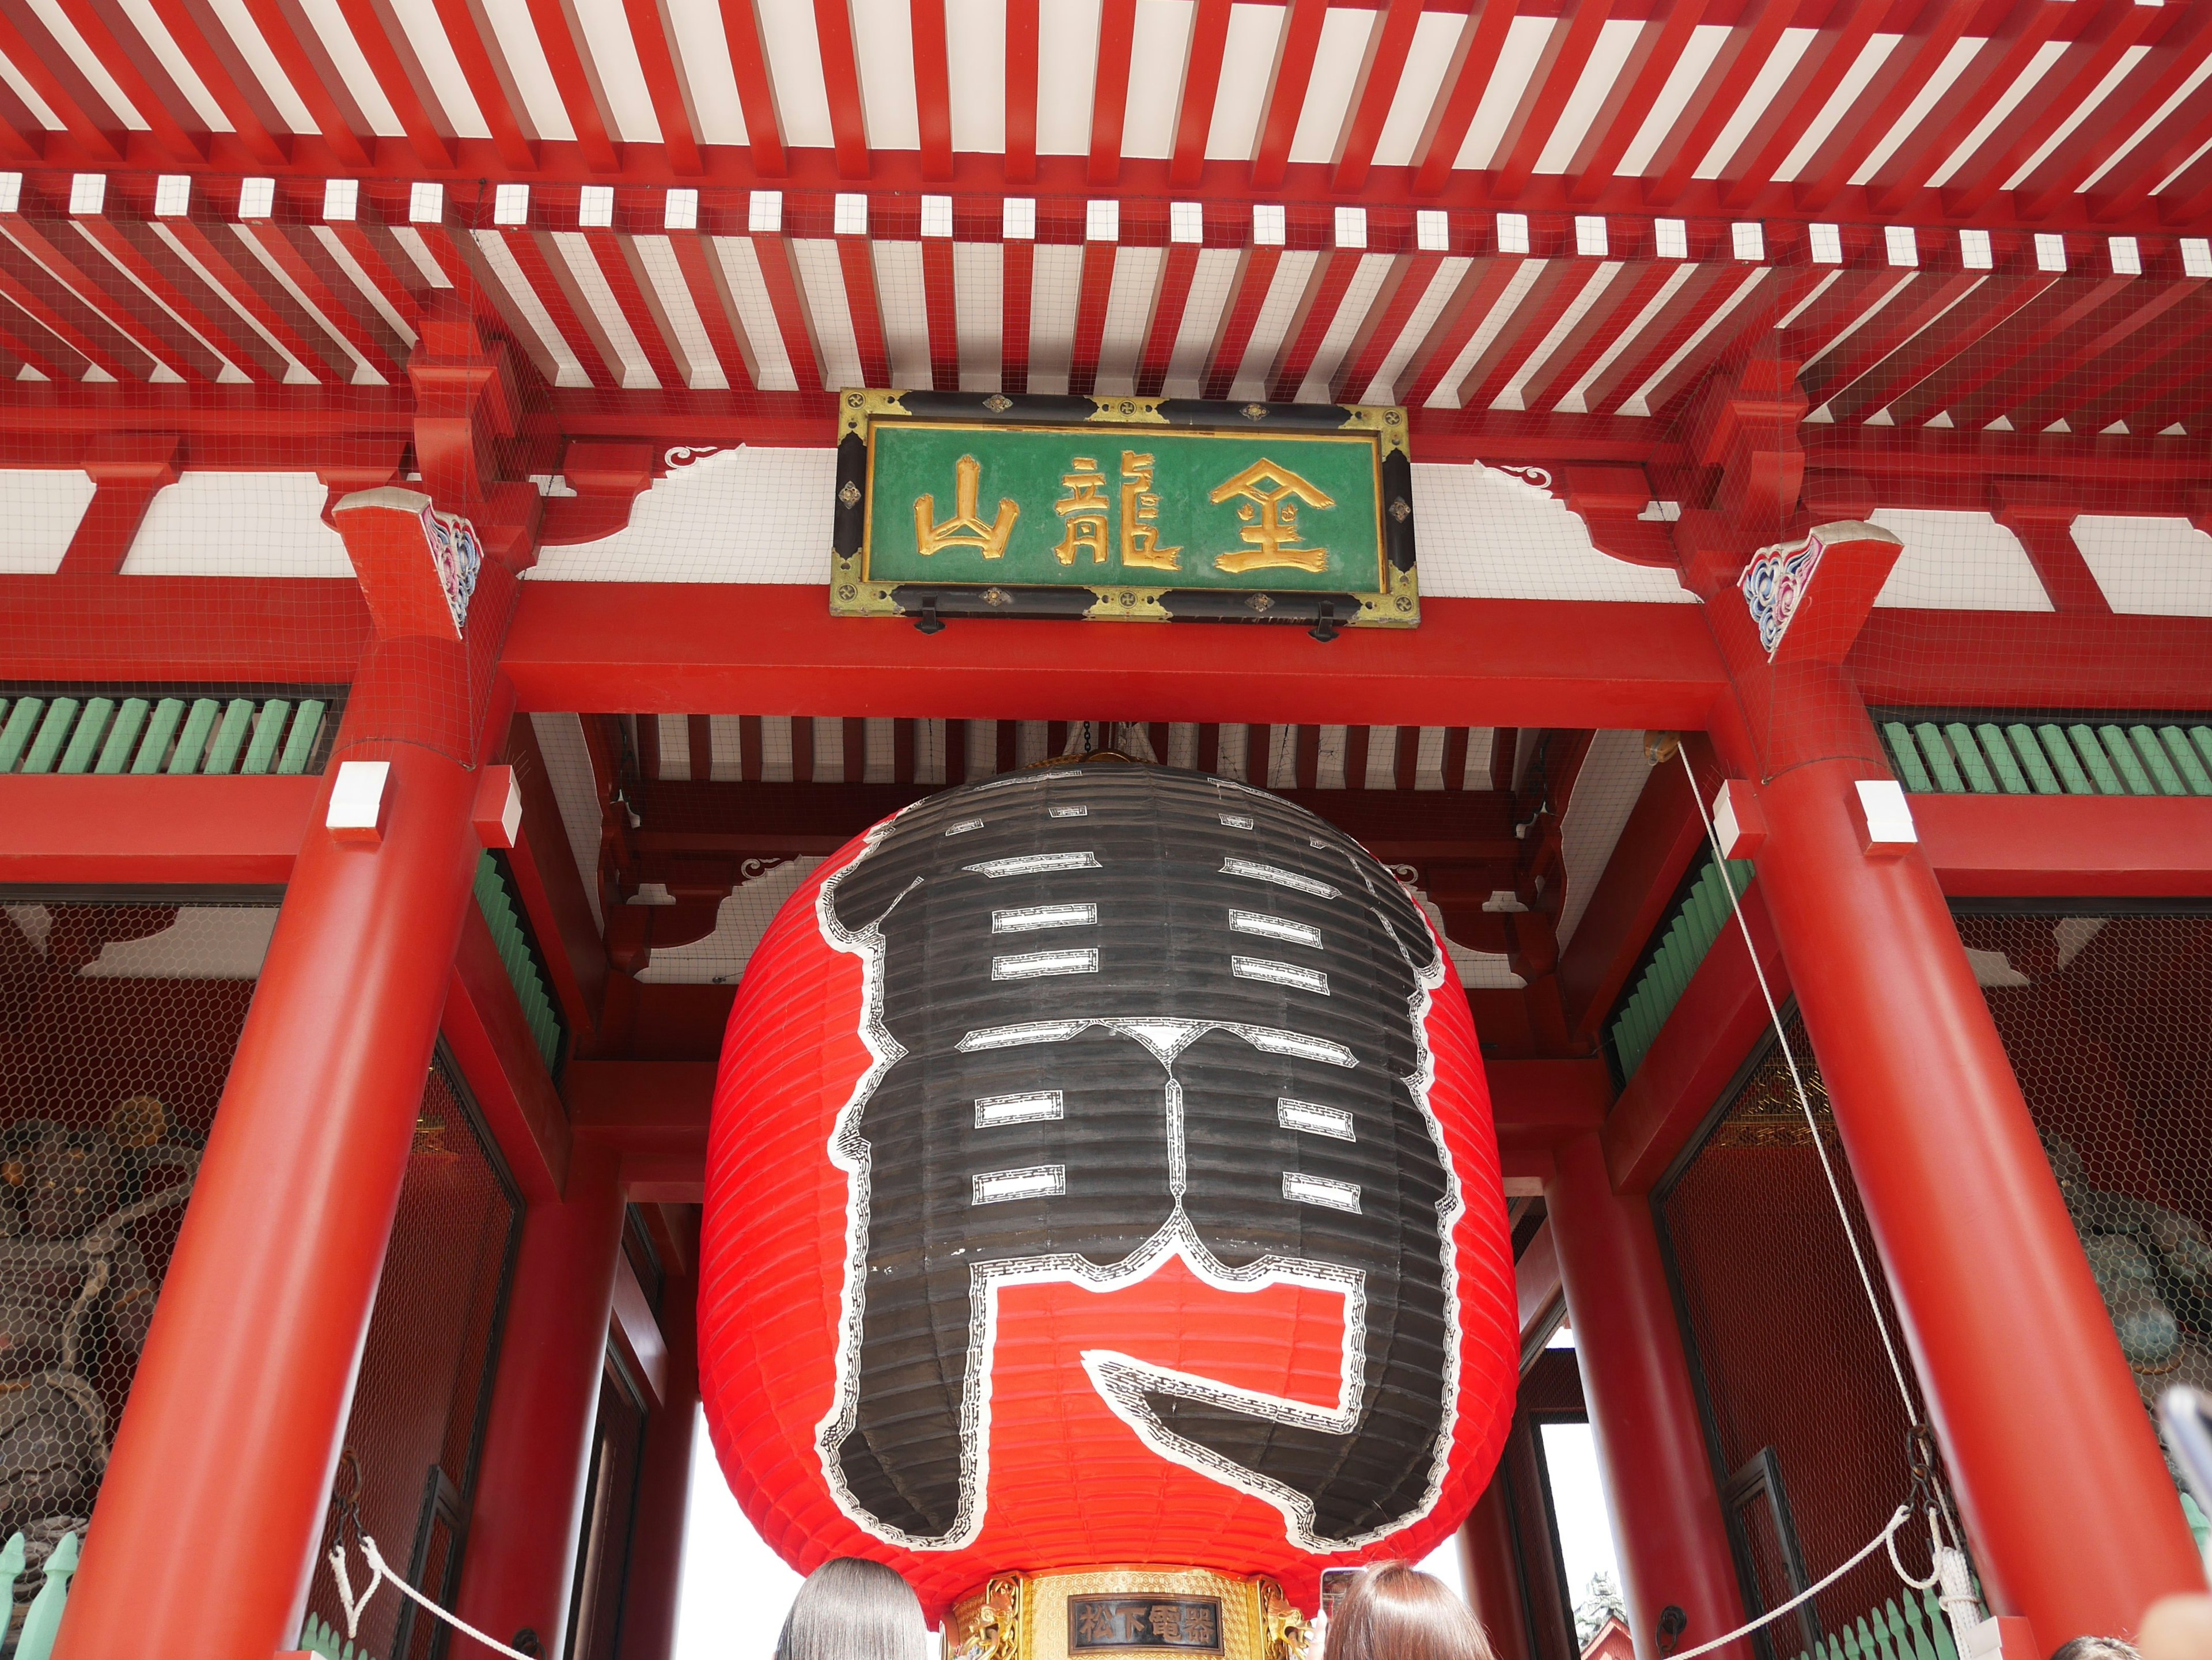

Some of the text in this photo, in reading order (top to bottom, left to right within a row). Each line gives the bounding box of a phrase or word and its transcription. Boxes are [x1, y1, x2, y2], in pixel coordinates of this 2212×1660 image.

[816, 762, 1463, 1554] 雷門
[1079, 1604, 1215, 1644] 松下電器
